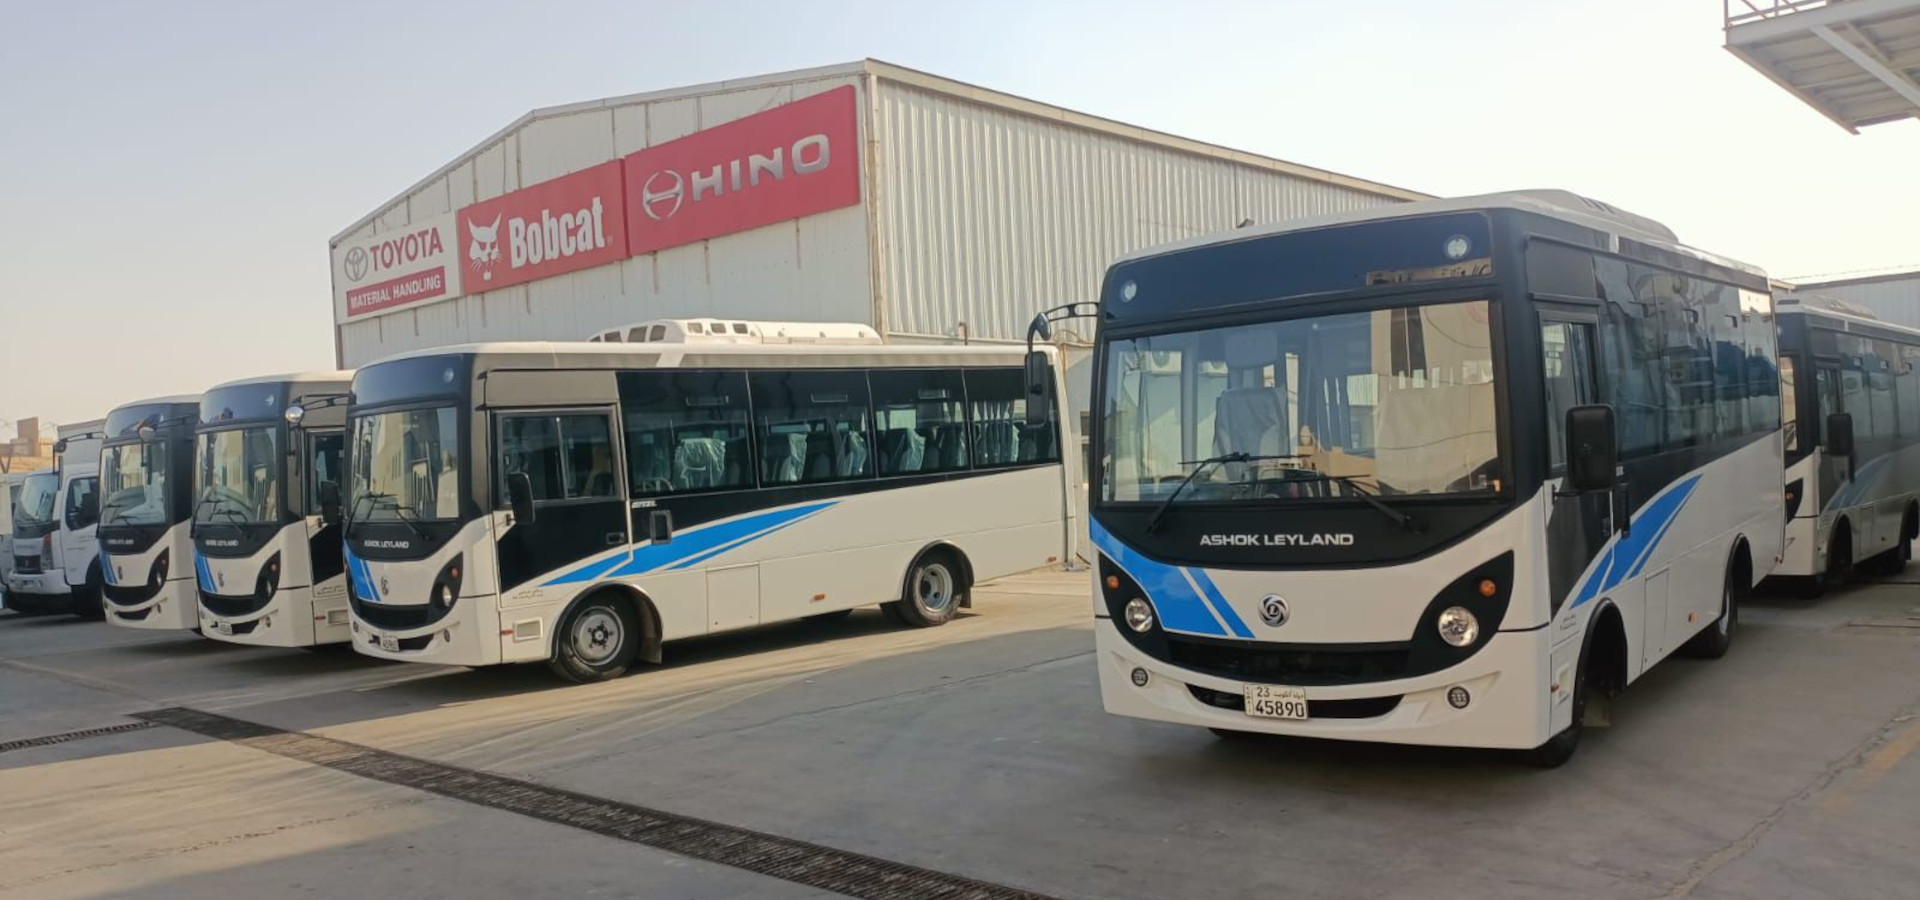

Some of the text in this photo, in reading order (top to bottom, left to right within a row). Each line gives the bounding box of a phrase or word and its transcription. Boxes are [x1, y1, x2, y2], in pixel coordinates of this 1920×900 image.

[691, 133, 830, 202] HINO
[370, 227, 444, 272] TOYOTA
[508, 196, 606, 269] Bobcat
[350, 275, 442, 310] MATERIAL HANDLING
[1200, 533, 1354, 546] ASHOK LEYLAND
[1256, 700, 1305, 718] 45890
[1257, 686, 1270, 698] 23
